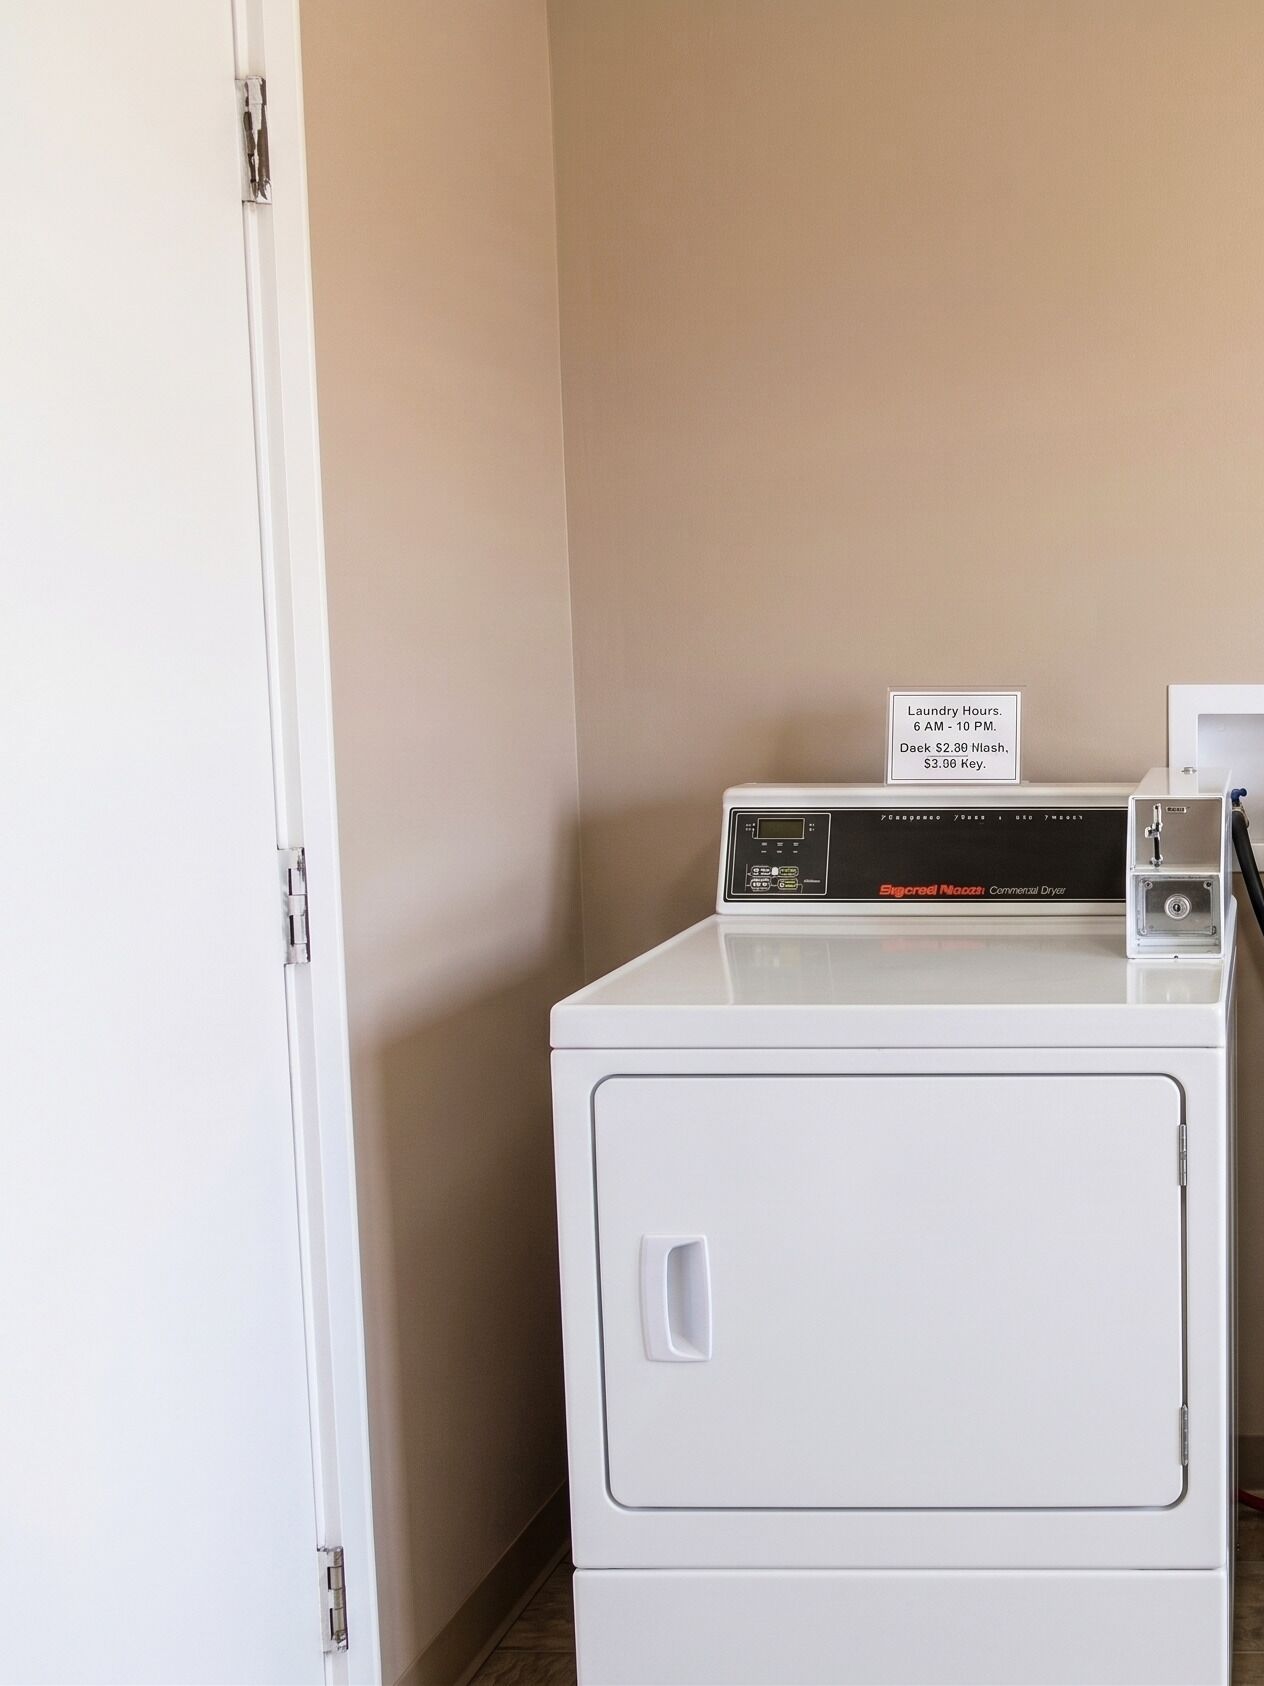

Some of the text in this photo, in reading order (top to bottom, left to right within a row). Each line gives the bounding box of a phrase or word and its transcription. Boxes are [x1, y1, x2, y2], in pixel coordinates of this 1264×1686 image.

[908, 705, 959, 718] Laundry
[913, 721, 921, 731] 6
[924, 721, 944, 731] AM
[956, 721, 970, 731] 10
